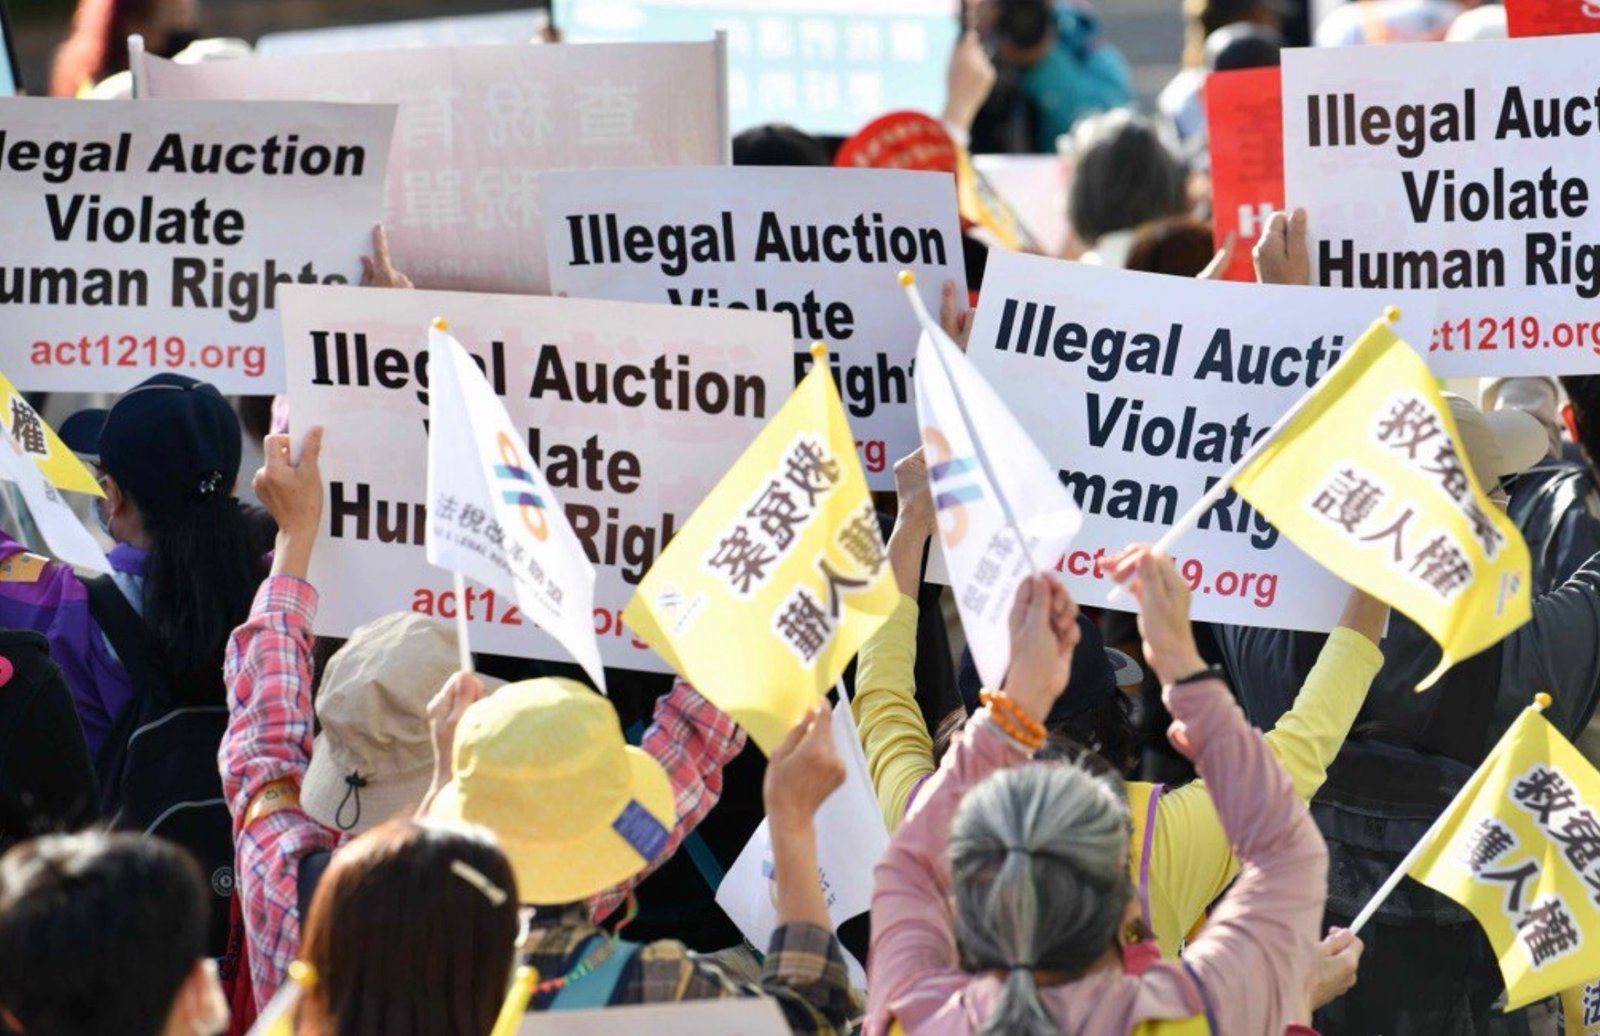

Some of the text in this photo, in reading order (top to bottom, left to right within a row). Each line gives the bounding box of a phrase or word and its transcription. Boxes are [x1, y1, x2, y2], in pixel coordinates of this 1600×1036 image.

[1307, 88, 1476, 158] Illegal
[147, 133, 365, 176] Auction
[45, 194, 244, 245] Violate
[1402, 165, 1589, 223] Violate
[566, 211, 948, 276] Illegal Auction
[1319, 239, 1504, 289] Human
[31, 334, 266, 377] act1219.org
[995, 298, 1344, 388] Illegal Aucti
[1429, 316, 1600, 354] t1219.or
[309, 331, 767, 418] Illel Auction
[1086, 392, 1272, 464] Violat
[1058, 469, 1178, 525] man
[1312, 469, 1472, 598] 護人權
[1514, 768, 1600, 905] 救冤
